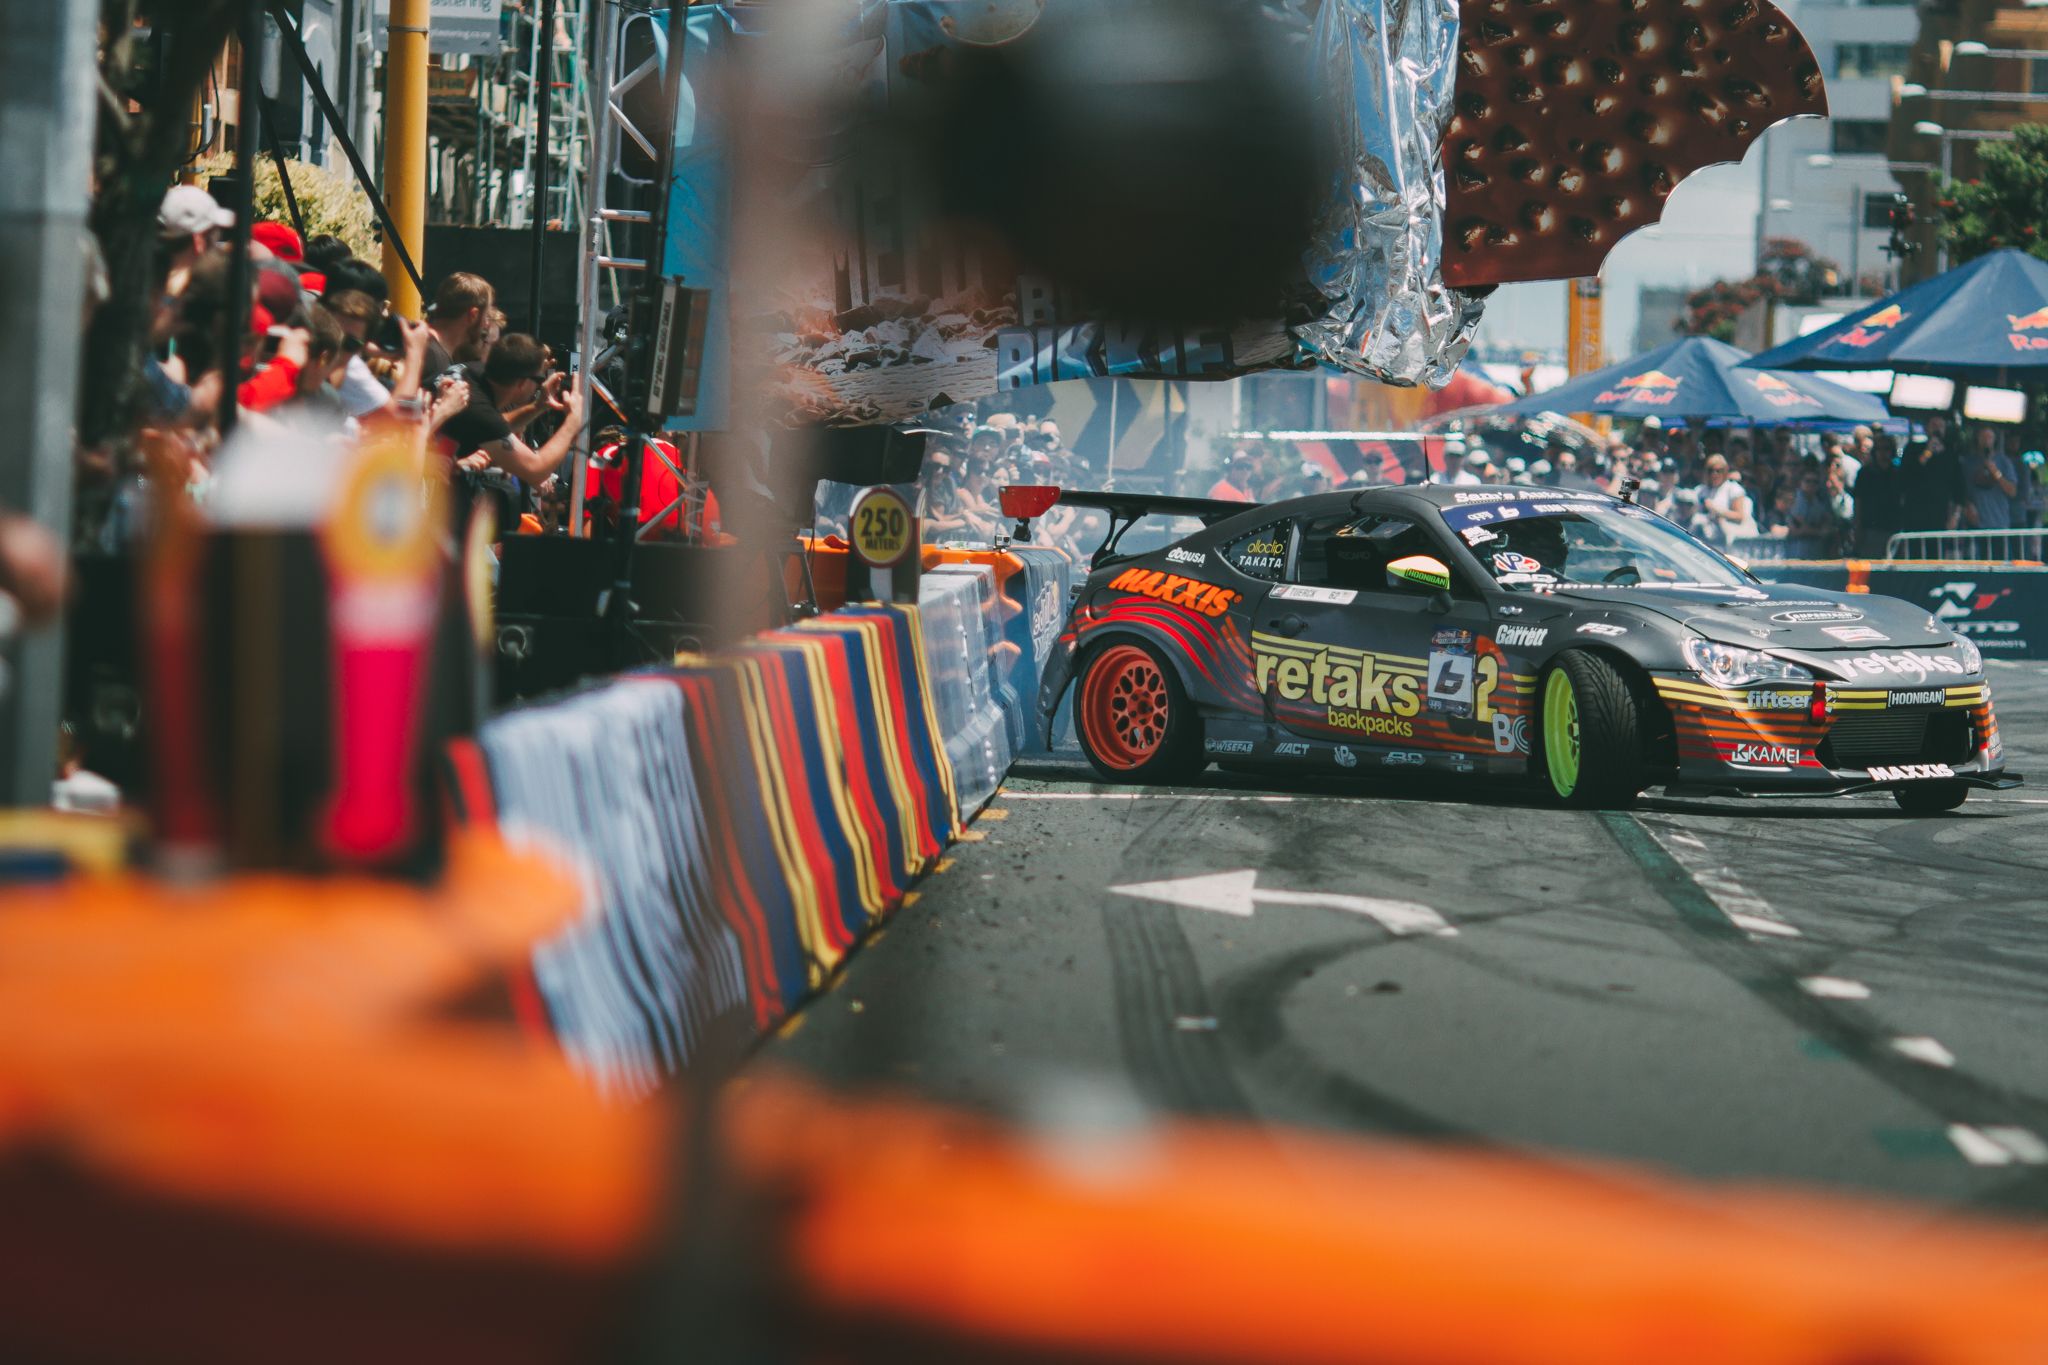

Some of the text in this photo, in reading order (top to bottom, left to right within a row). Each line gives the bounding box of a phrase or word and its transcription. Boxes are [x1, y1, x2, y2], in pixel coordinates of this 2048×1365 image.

[861, 507, 904, 537] 250
[1239, 555, 1282, 568] TAKATA
[1108, 567, 1236, 618] MAXXIS
[1495, 624, 1549, 646] Garrett
[1834, 651, 1964, 677] retaks
[1256, 647, 1421, 718] retaks
[1477, 655, 1499, 724] 2
[1328, 706, 1414, 738] backpacks
[1748, 745, 1800, 764] KAMEI
[1867, 763, 1955, 781] MAXXIS
